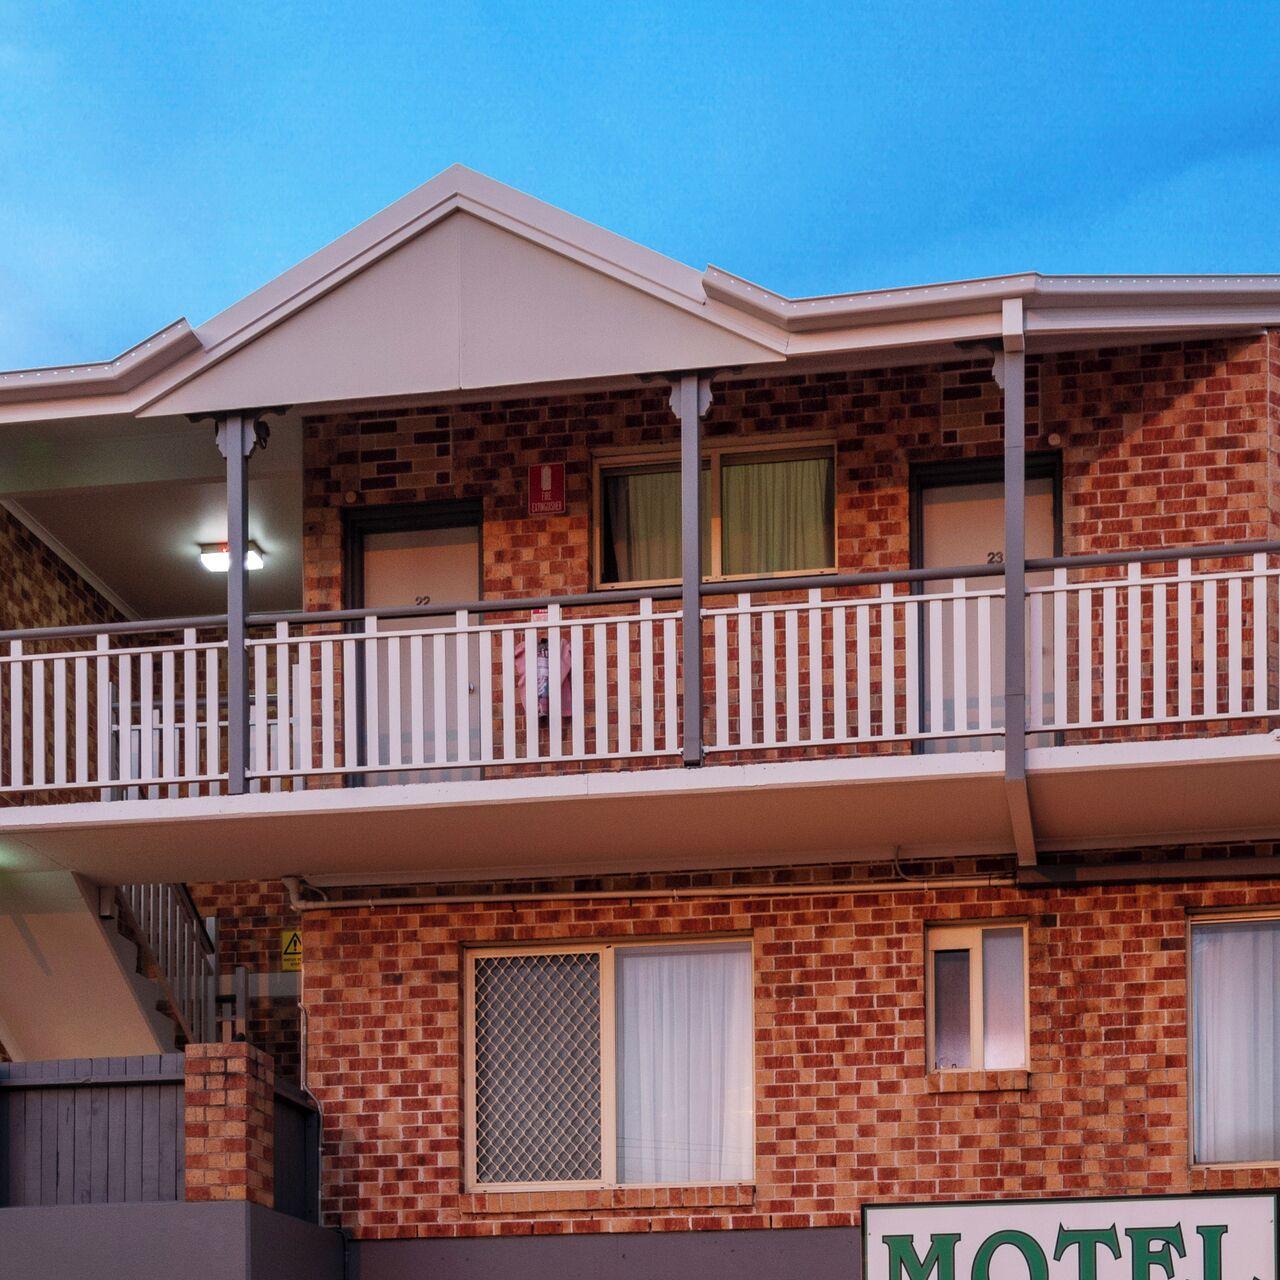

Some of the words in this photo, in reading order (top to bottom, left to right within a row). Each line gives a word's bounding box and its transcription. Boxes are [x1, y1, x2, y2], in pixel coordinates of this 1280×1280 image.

[541, 491, 552, 500] FIRE
[531, 501, 562, 513] EXTINGUISHER
[987, 551, 1004, 564] 23
